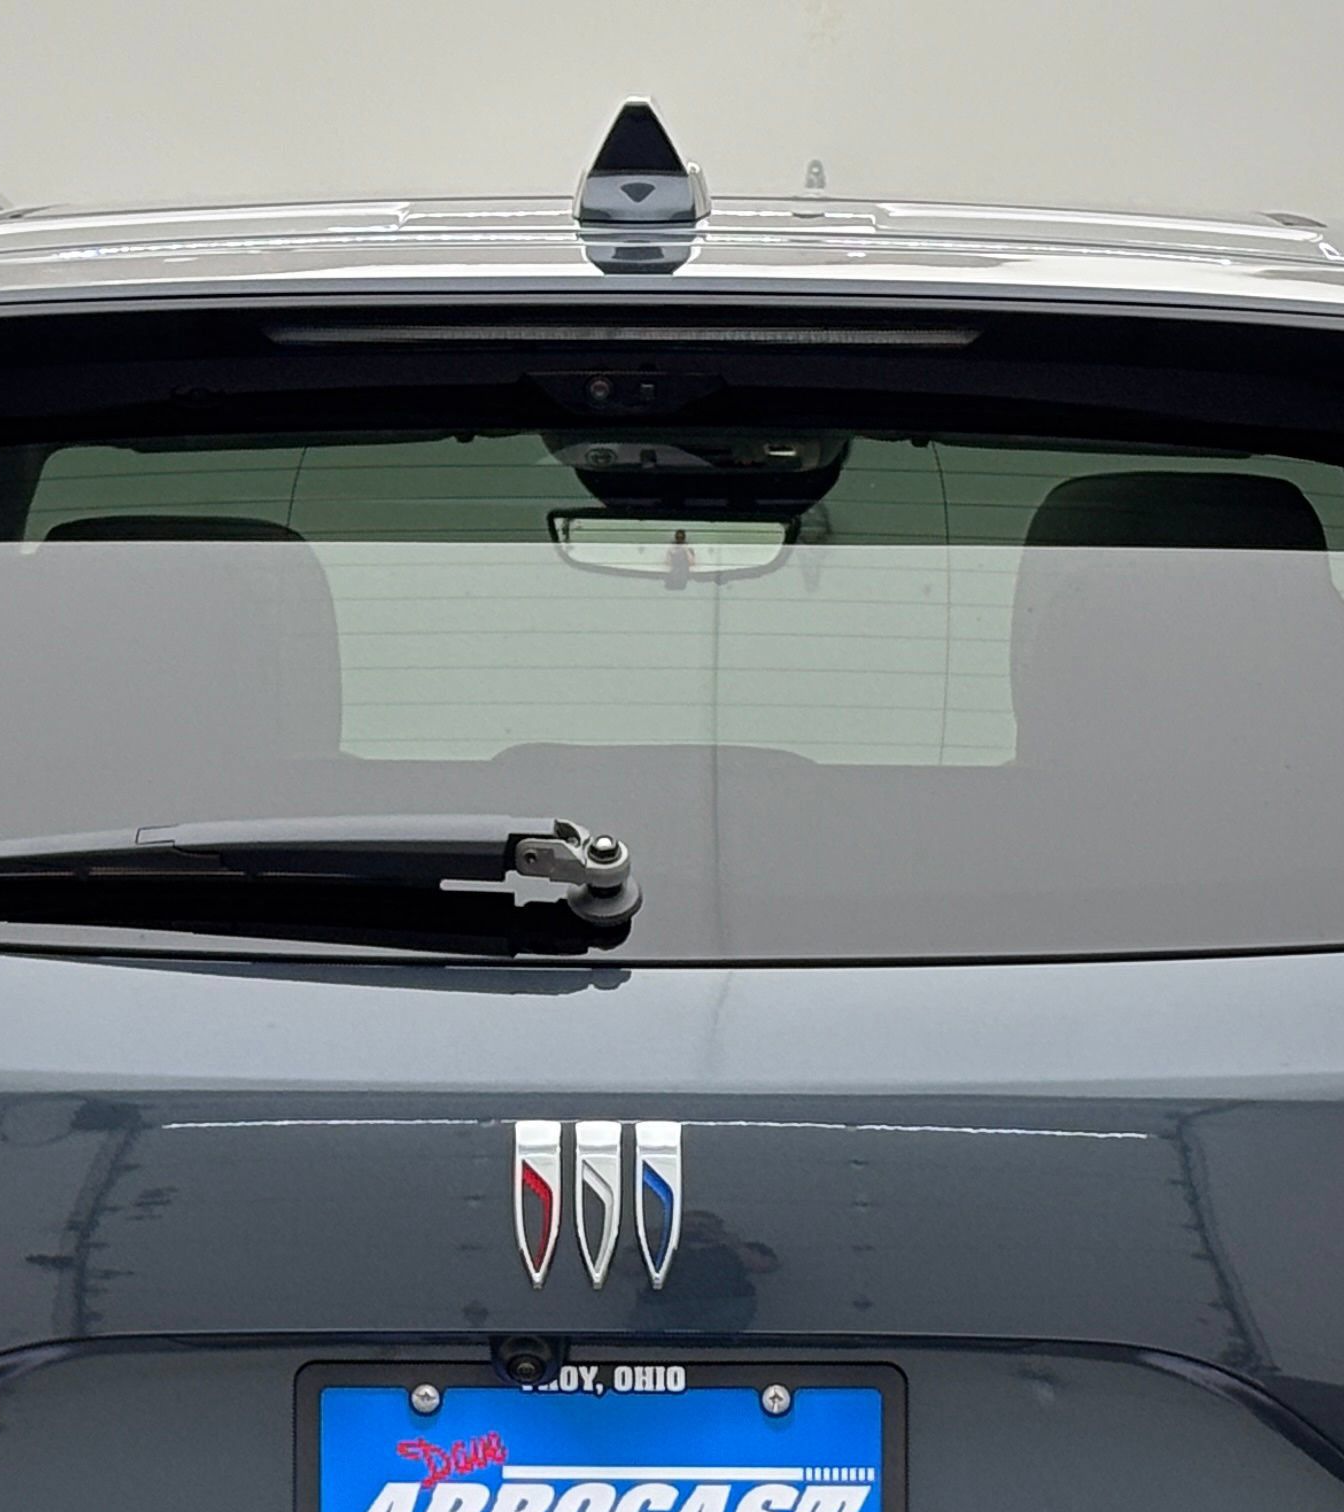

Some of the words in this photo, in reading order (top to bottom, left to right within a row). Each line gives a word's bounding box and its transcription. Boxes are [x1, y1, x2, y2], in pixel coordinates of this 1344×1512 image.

[521, 1365, 604, 1395] OY,
[613, 1365, 686, 1393] OHIO
[396, 1431, 508, 1489] Dave
